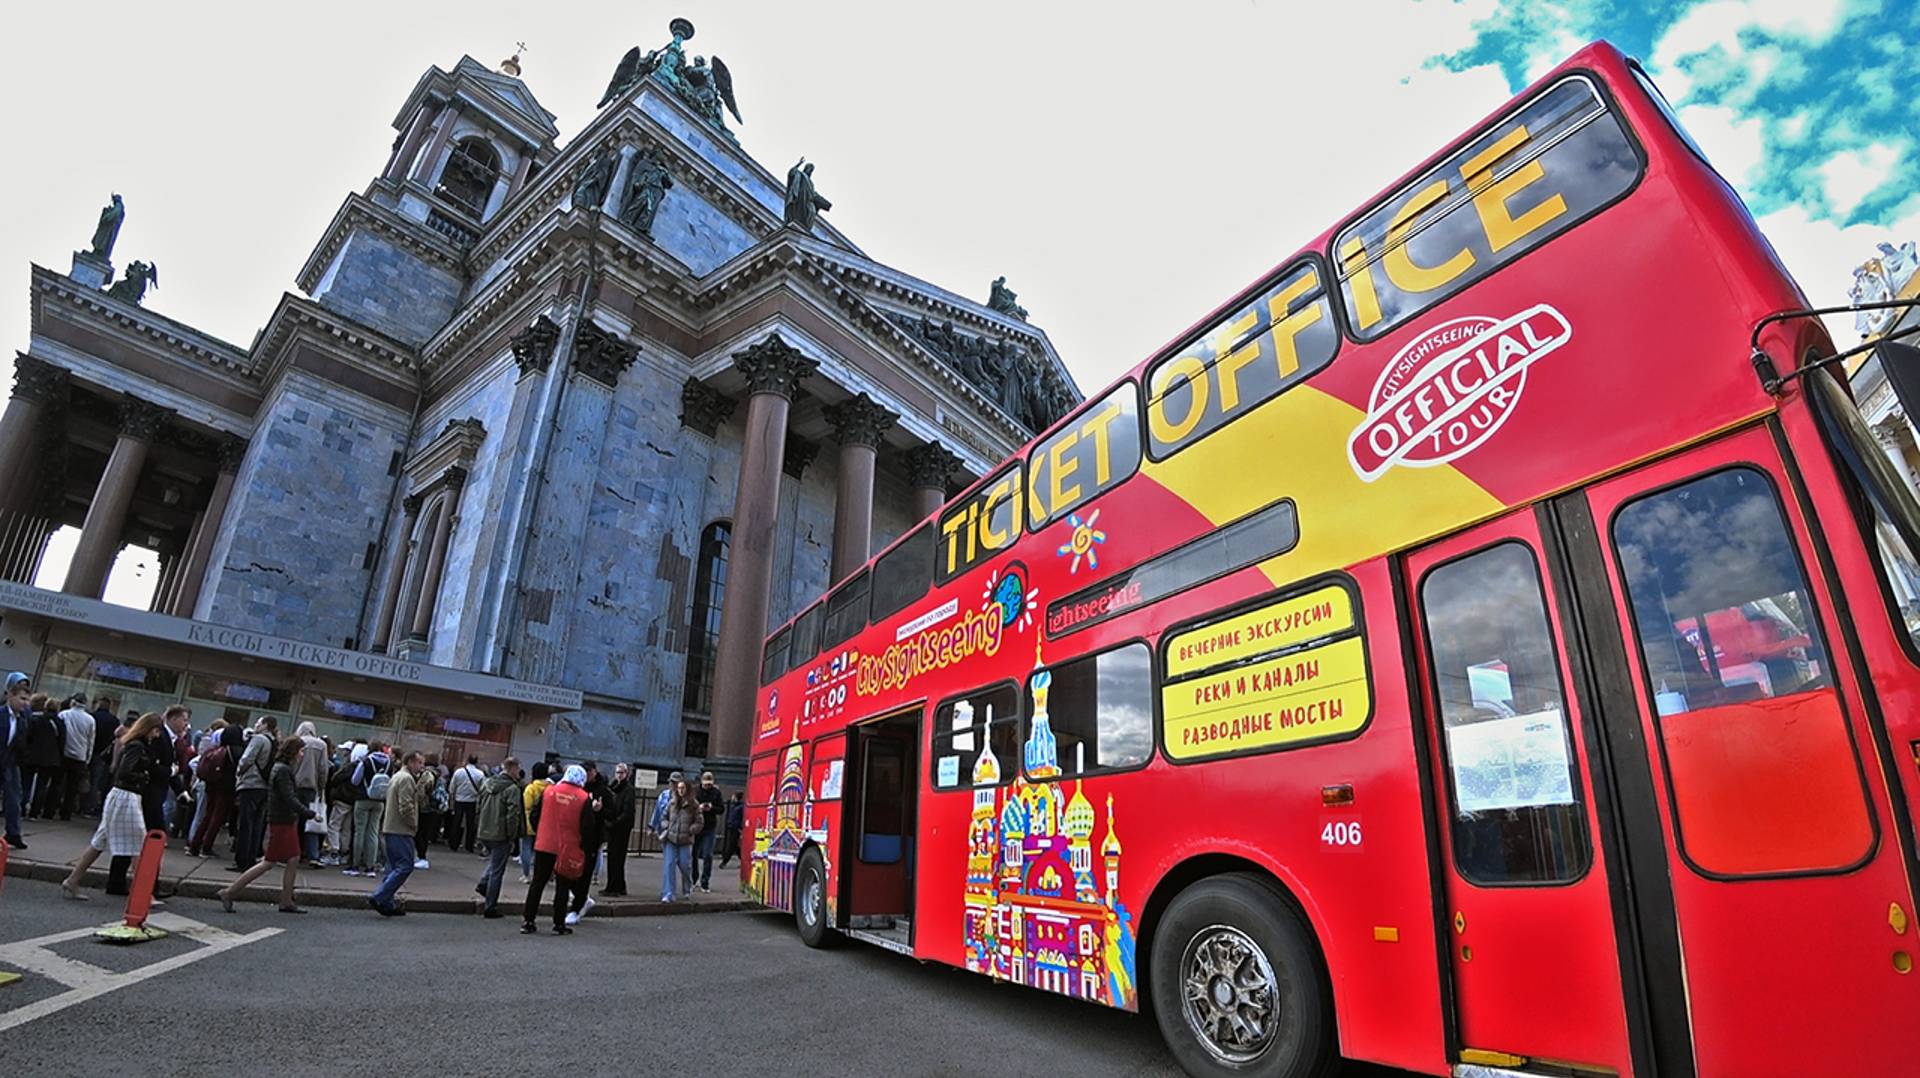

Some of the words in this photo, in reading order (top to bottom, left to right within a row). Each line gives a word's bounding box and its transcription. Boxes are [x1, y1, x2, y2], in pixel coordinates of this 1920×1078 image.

[943, 402, 1122, 574] TICKET
[1148, 124, 1567, 444] OFFICE
[1382, 322, 1486, 401] CITYSIGHTSEEING
[1369, 321, 1553, 457] OFFICIAL
[1429, 386, 1514, 452] TOUR
[187, 624, 263, 652] КАССЫ
[278, 641, 350, 667] TICKET
[355, 654, 421, 680] OFFICE
[1179, 630, 1241, 661] ВЕЧЕРНИЕ
[1247, 601, 1333, 642] ЭКСКУРСИИ
[1195, 676, 1231, 705] РЕКИ
[1236, 673, 1246, 696] И
[1252, 659, 1319, 692] КАНАЛЫ
[1183, 712, 1272, 746] РАЗВОДНЫЕ
[1280, 699, 1343, 729] МОСТЫ
[1321, 821, 1362, 845] 406
